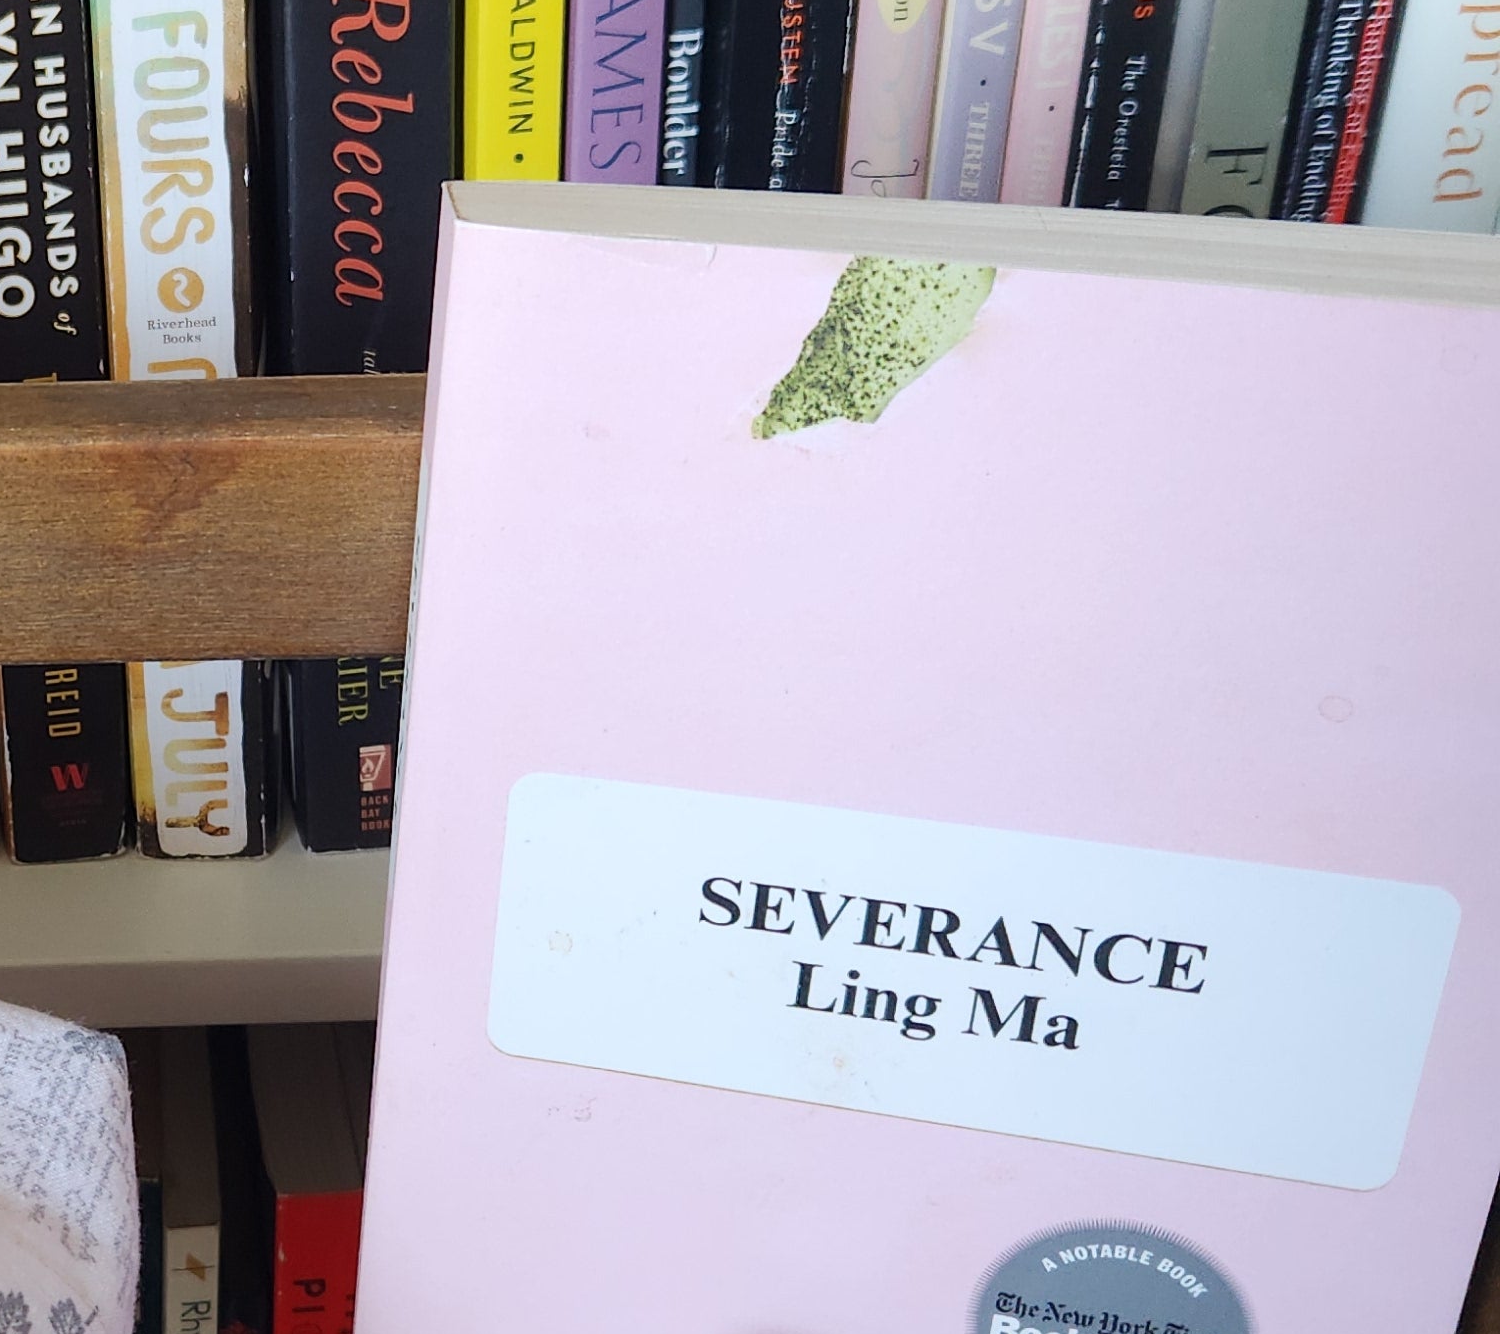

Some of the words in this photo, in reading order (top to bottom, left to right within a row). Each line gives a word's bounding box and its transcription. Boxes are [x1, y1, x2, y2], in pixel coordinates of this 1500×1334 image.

[967, 21, 1011, 57] V
[1120, 54, 1149, 93] The
[131, 9, 218, 257] FOURS
[662, 29, 705, 176] Boulder
[31, 54, 80, 300] HUSBANDS
[57, 312, 78, 337] of
[147, 316, 218, 332] Riverhead
[162, 331, 203, 346] Books
[44, 667, 83, 738] REID
[160, 687, 231, 838] JULY
[698, 875, 1209, 996] SEVERANCE
[786, 959, 943, 1042] Ling
[961, 985, 1081, 1052] Ma
[1040, 1257, 1058, 1273] A
[1058, 1243, 1155, 1267] NOTABLE
[1156, 1257, 1208, 1299] BOOK
[994, 1291, 1041, 1319] The
[1041, 1300, 1096, 1329] New
